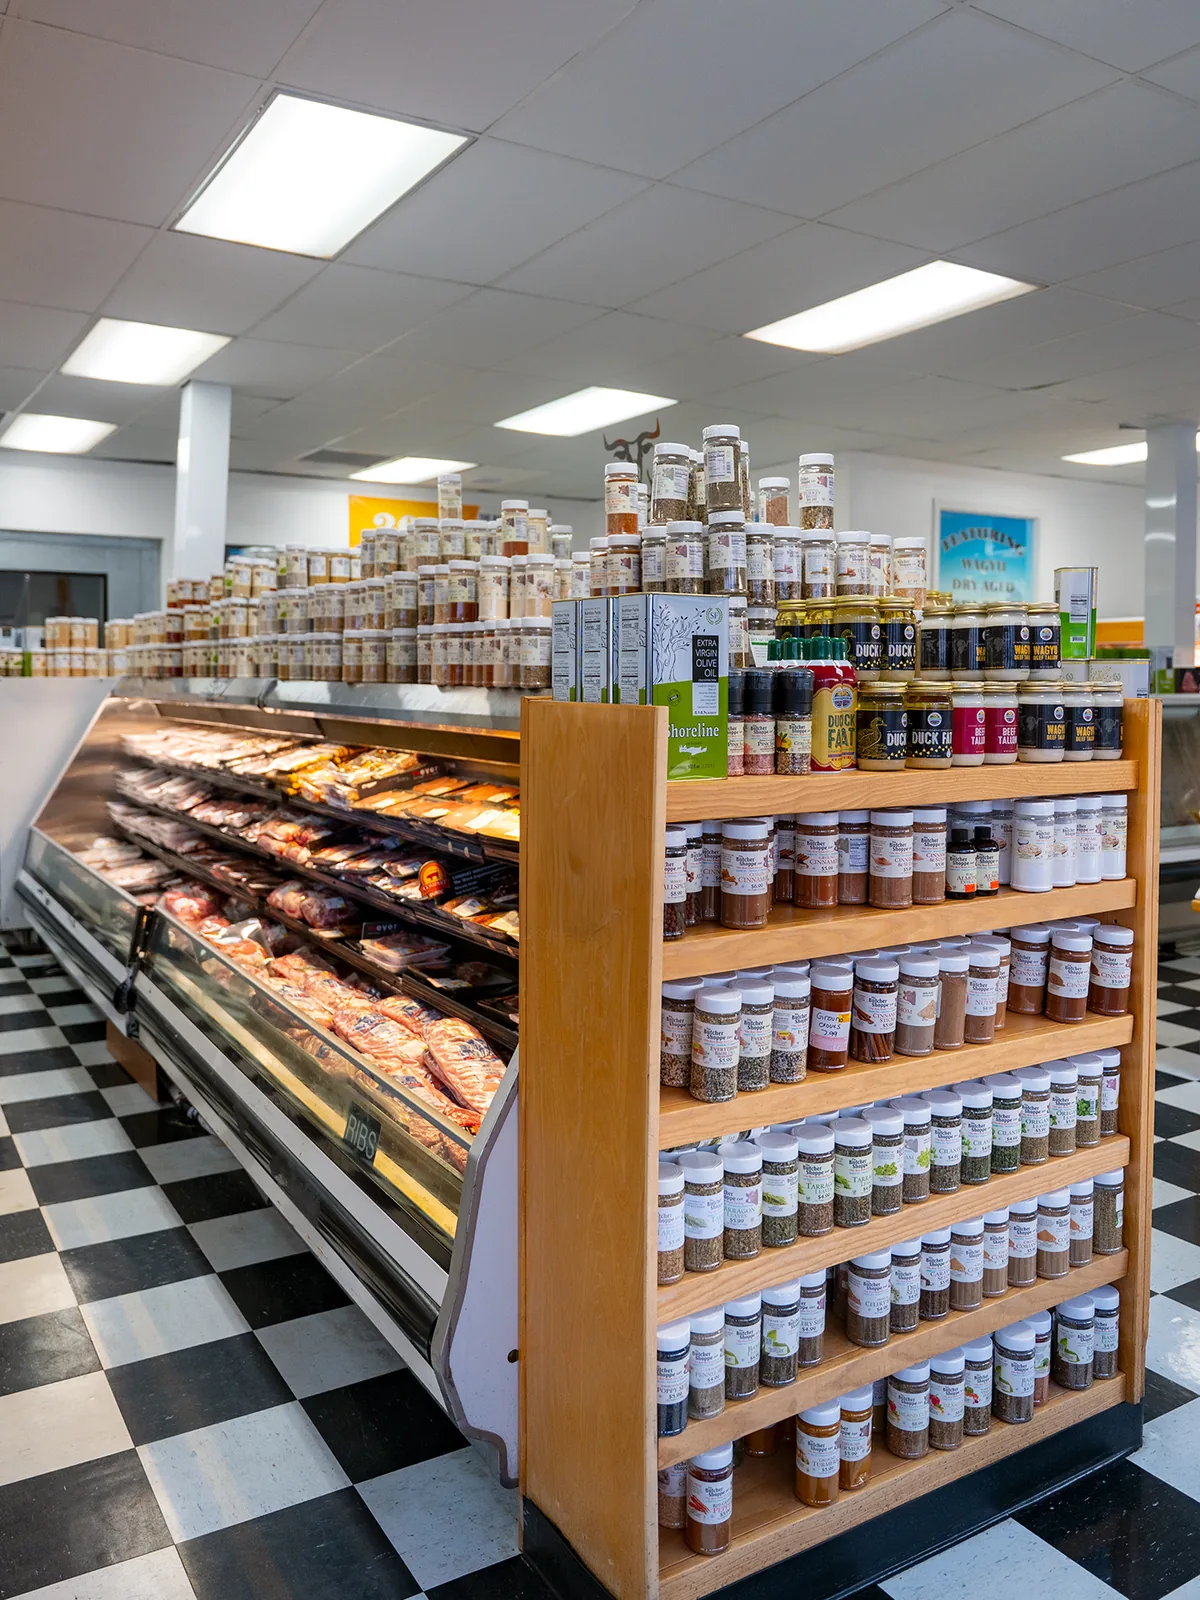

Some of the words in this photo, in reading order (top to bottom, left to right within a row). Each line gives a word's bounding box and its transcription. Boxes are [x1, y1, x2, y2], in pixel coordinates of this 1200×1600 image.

[942, 527, 1026, 557] FEATURING
[961, 558, 1007, 572] WAGYU
[952, 578, 977, 590] DRY
[984, 580, 1015, 593] AGED
[695, 649, 717, 657] VIRGIN
[856, 644, 879, 657] DUCK
[888, 644, 912, 657] DUCK
[1033, 645, 1058, 655] WAGYU
[696, 659, 717, 667] OLIVE
[704, 668, 716, 677] OIL
[912, 732, 939, 745] DUCK
[1003, 728, 1016, 736] BEEF
[816, 1012, 843, 1023] Ground
[346, 1114, 377, 1160] RIBS
